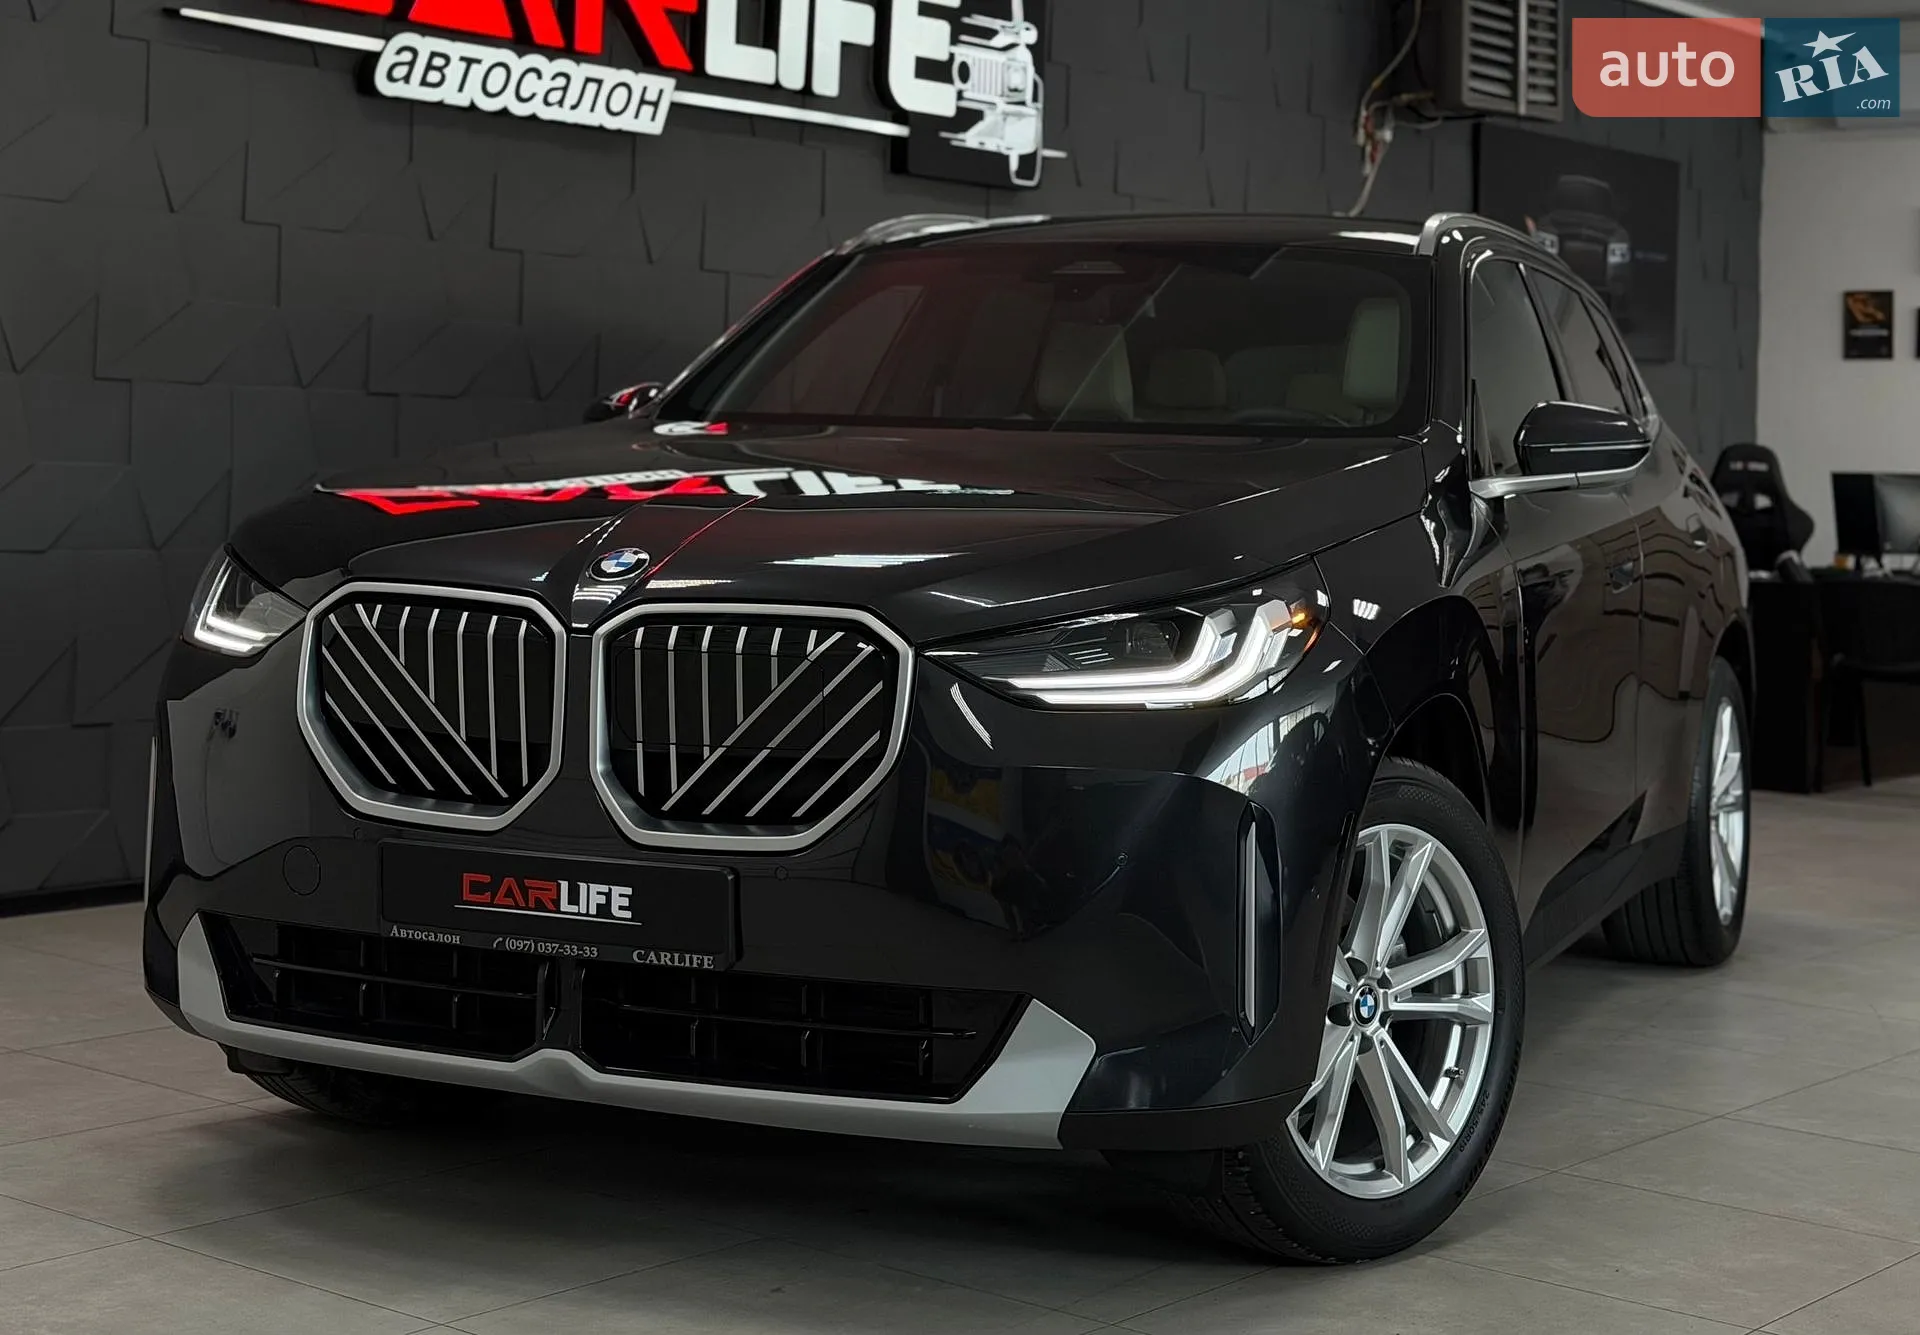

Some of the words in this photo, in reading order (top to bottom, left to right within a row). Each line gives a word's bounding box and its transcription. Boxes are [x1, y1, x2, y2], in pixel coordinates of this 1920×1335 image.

[308, 0, 956, 117] LIFE
[385, 45, 666, 123] автосалон
[463, 872, 632, 919] CARLIFE
[390, 924, 461, 945] Автосалон
[505, 936, 535, 953] (097)
[537, 942, 598, 958] 037-33-33
[632, 949, 714, 969] CARLIFE
